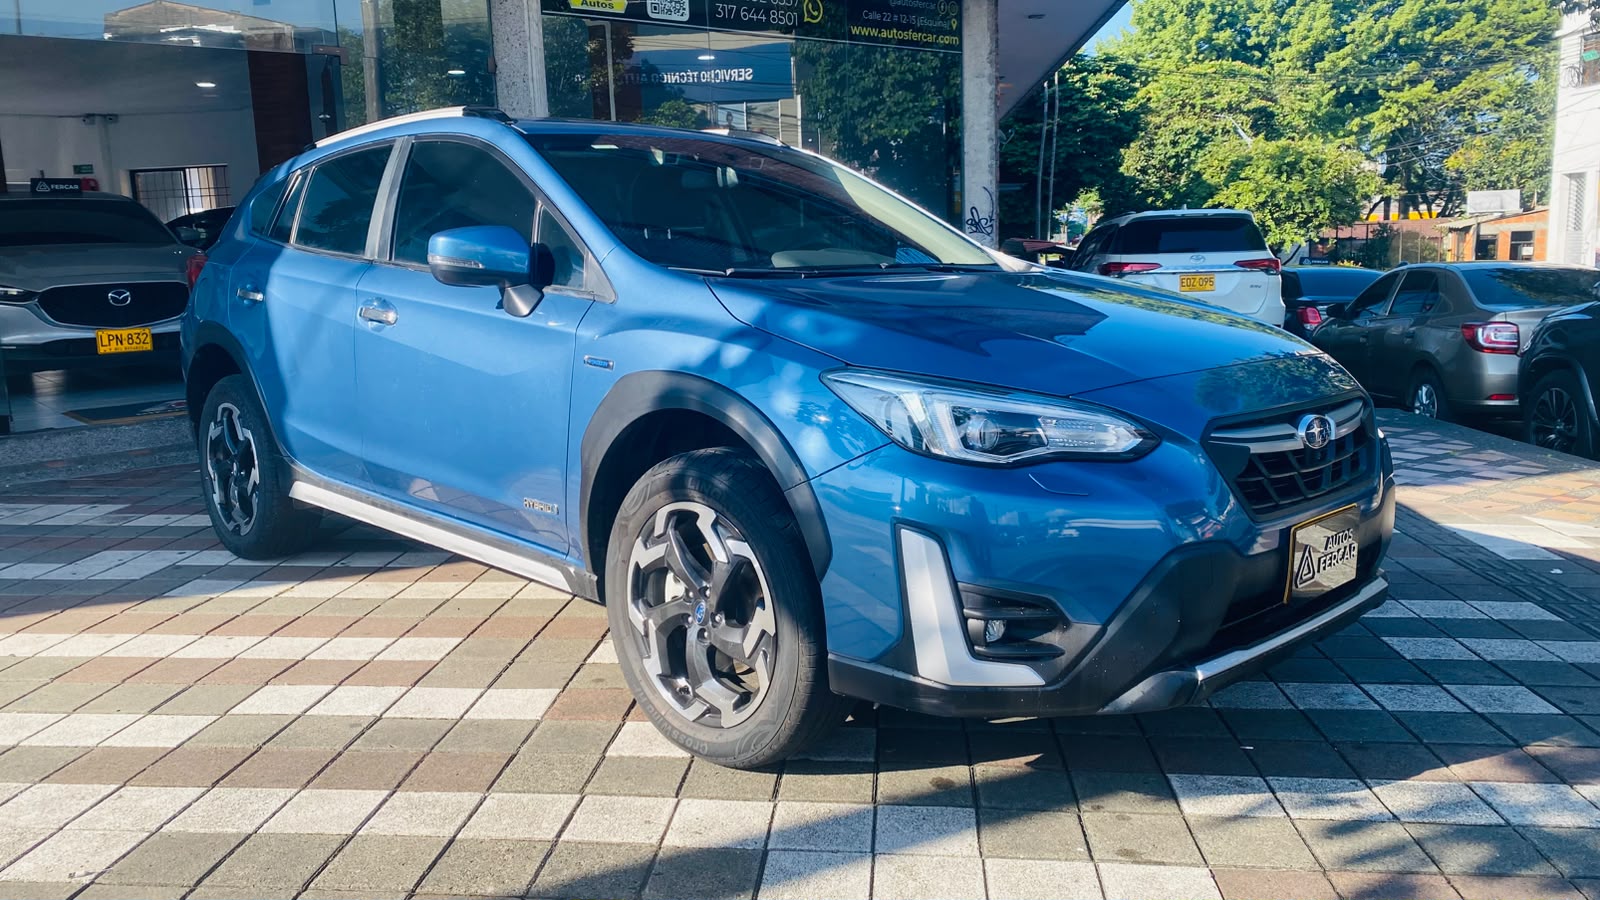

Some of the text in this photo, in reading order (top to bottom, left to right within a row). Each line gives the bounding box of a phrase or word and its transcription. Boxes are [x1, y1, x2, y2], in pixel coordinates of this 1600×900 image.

[580, 0, 614, 9] Autos
[715, 3, 737, 19] 317
[740, 6, 767, 22] 644
[769, 9, 798, 26] 8501
[862, 9, 881, 20] Calle
[882, 12, 892, 22] 22
[850, 25, 959, 45] www.autosfercar.com
[1324, 528, 1353, 551] AUTOS
[1317, 543, 1356, 574] FERCAR
